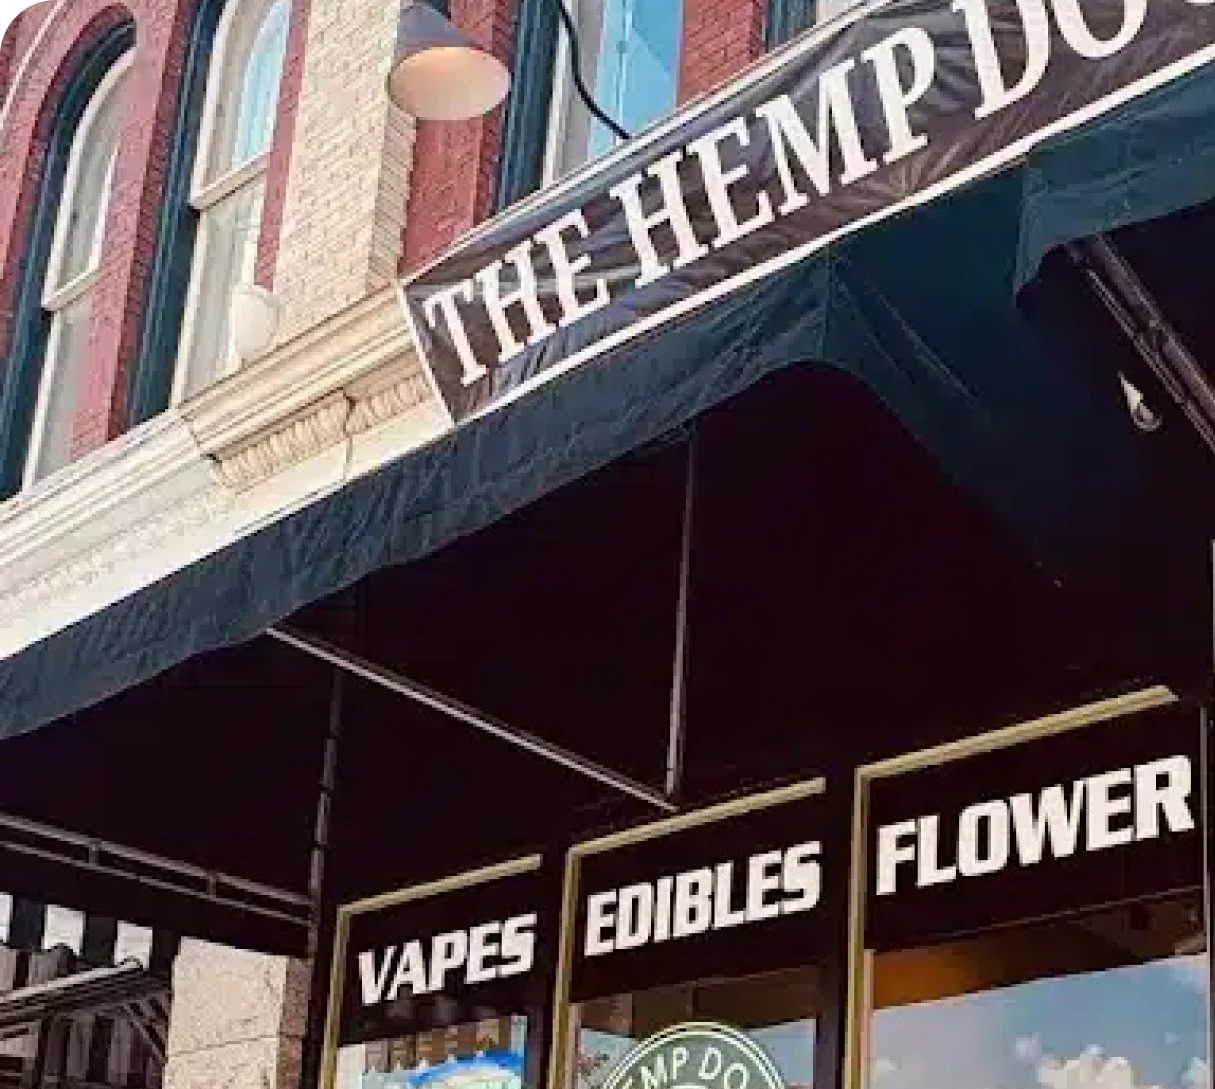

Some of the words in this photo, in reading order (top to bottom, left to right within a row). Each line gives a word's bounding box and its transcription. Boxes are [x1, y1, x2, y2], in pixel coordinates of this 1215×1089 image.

[423, 207, 607, 387] THE
[609, 25, 939, 287] HEMP
[876, 755, 1195, 896] FLOWER
[358, 913, 537, 1006] VAPES
[584, 840, 822, 957] EDIBLES
